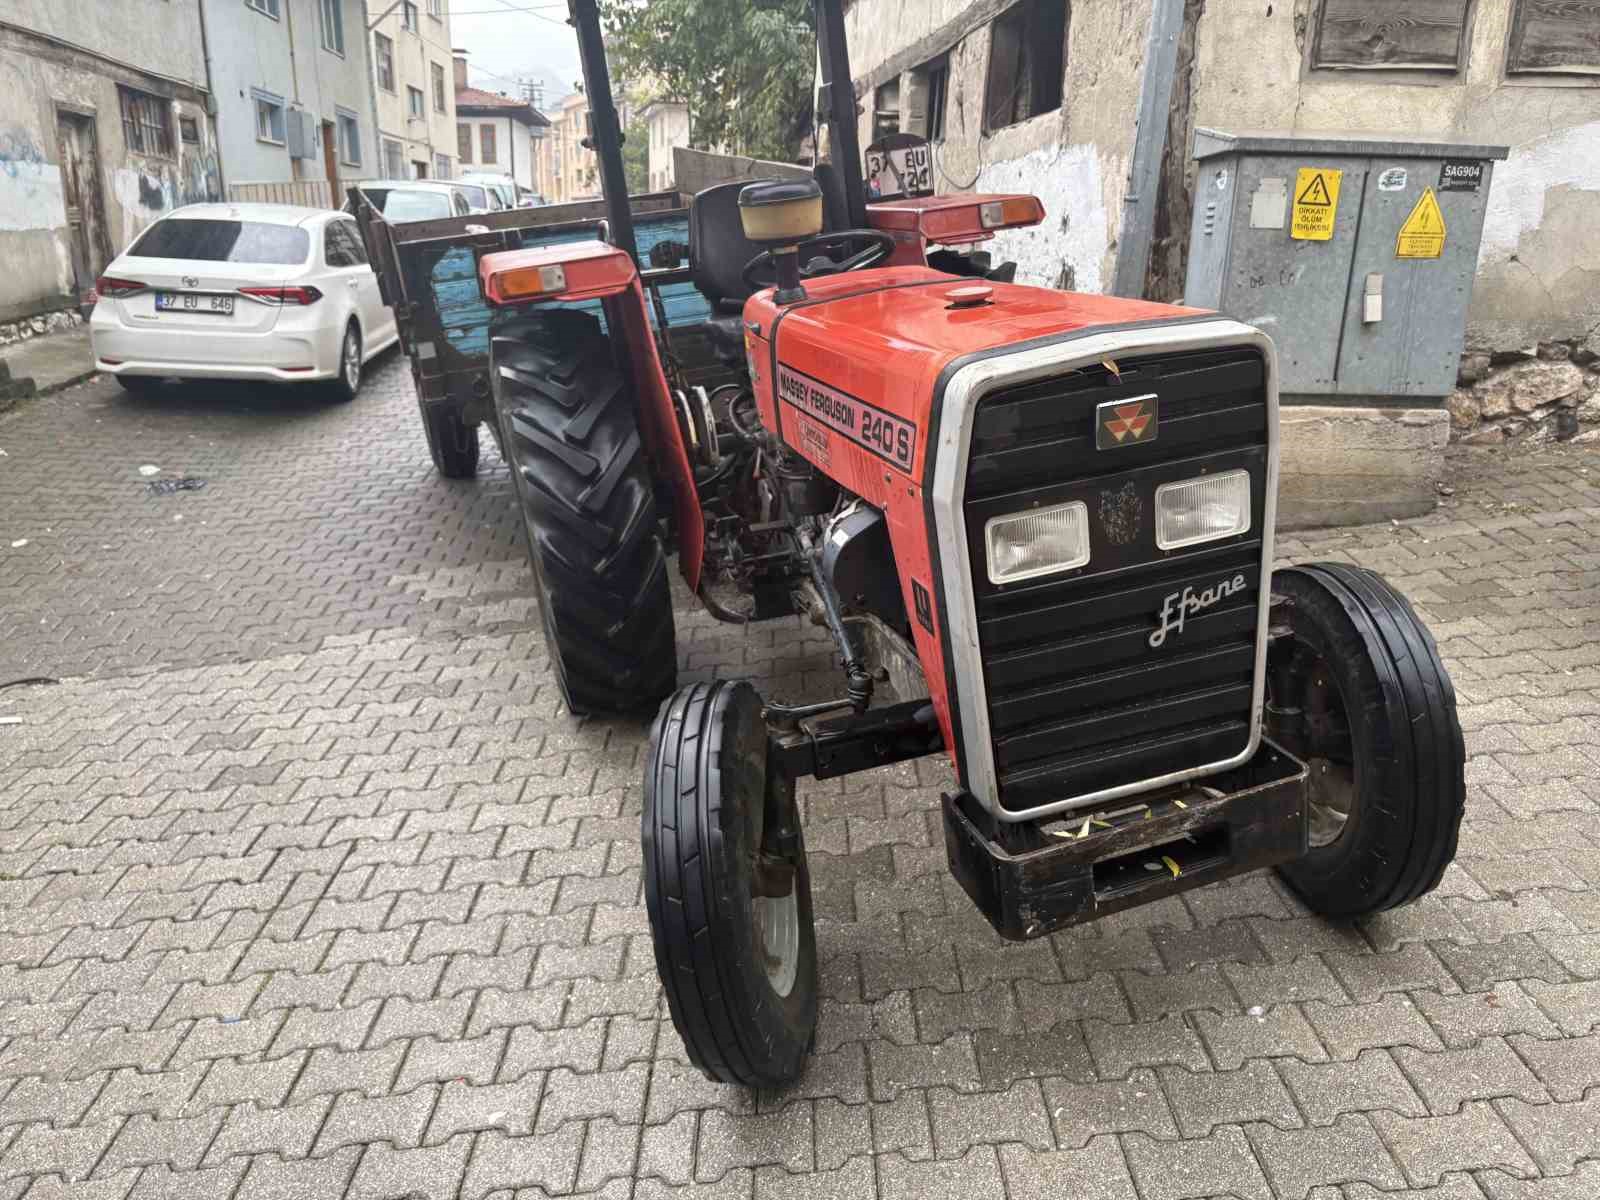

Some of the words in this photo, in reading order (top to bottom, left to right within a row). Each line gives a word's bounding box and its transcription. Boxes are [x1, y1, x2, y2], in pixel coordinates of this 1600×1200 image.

[905, 150, 926, 169] EU
[163, 295, 176, 306] 37
[183, 296, 198, 309] EU
[210, 297, 231, 310] 646
[780, 374, 809, 403] MASSEY
[810, 388, 854, 428] FERGUSON
[862, 411, 893, 453] 240
[897, 427, 909, 462] S
[1149, 574, 1247, 647] Efsane
